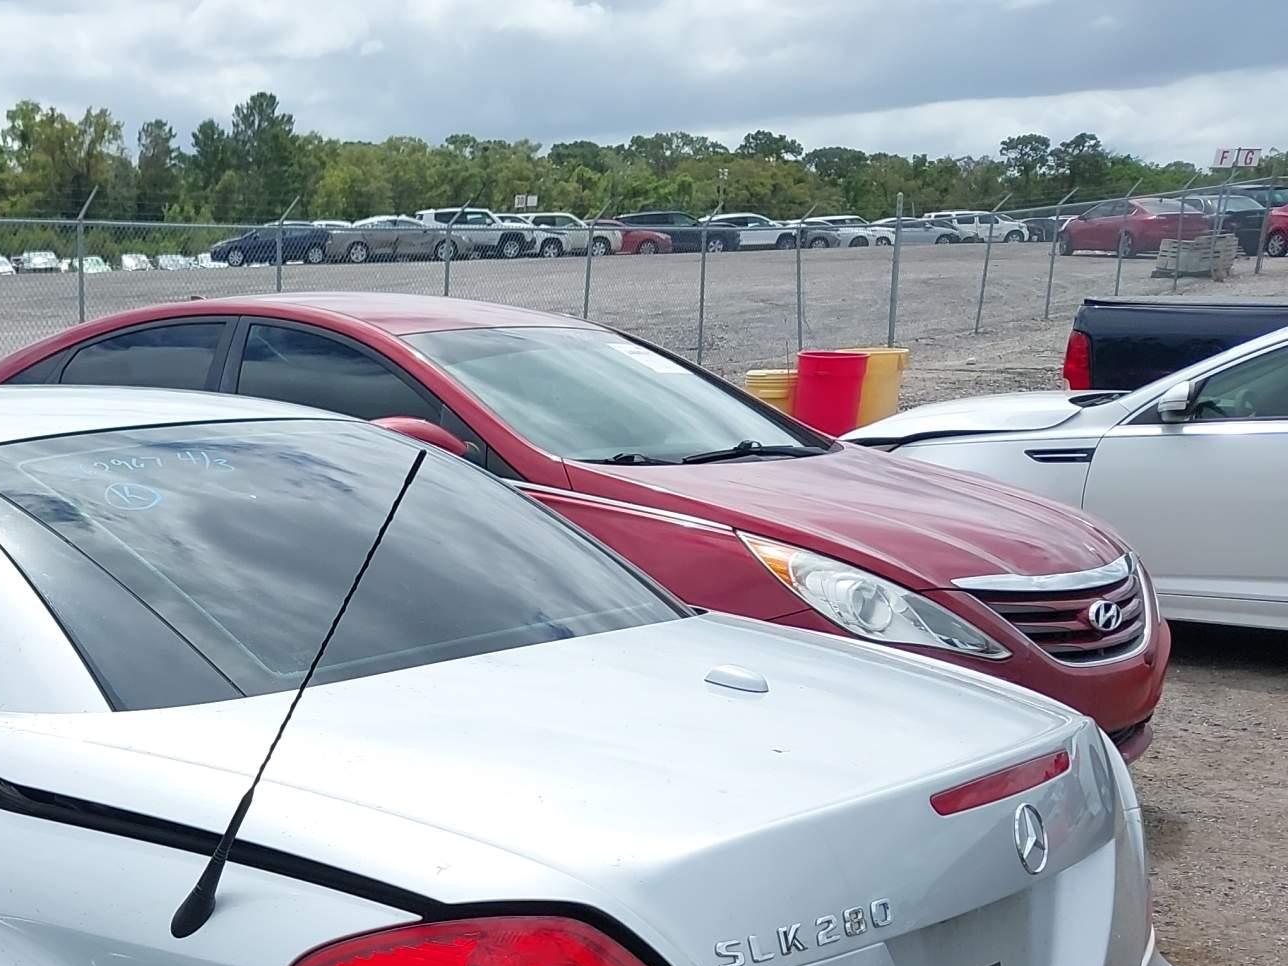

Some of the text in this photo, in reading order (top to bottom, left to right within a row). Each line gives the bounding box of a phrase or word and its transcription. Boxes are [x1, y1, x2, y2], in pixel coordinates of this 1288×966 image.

[1219, 150, 1230, 166] F
[1244, 150, 1255, 166] G
[815, 898, 892, 947] 280
